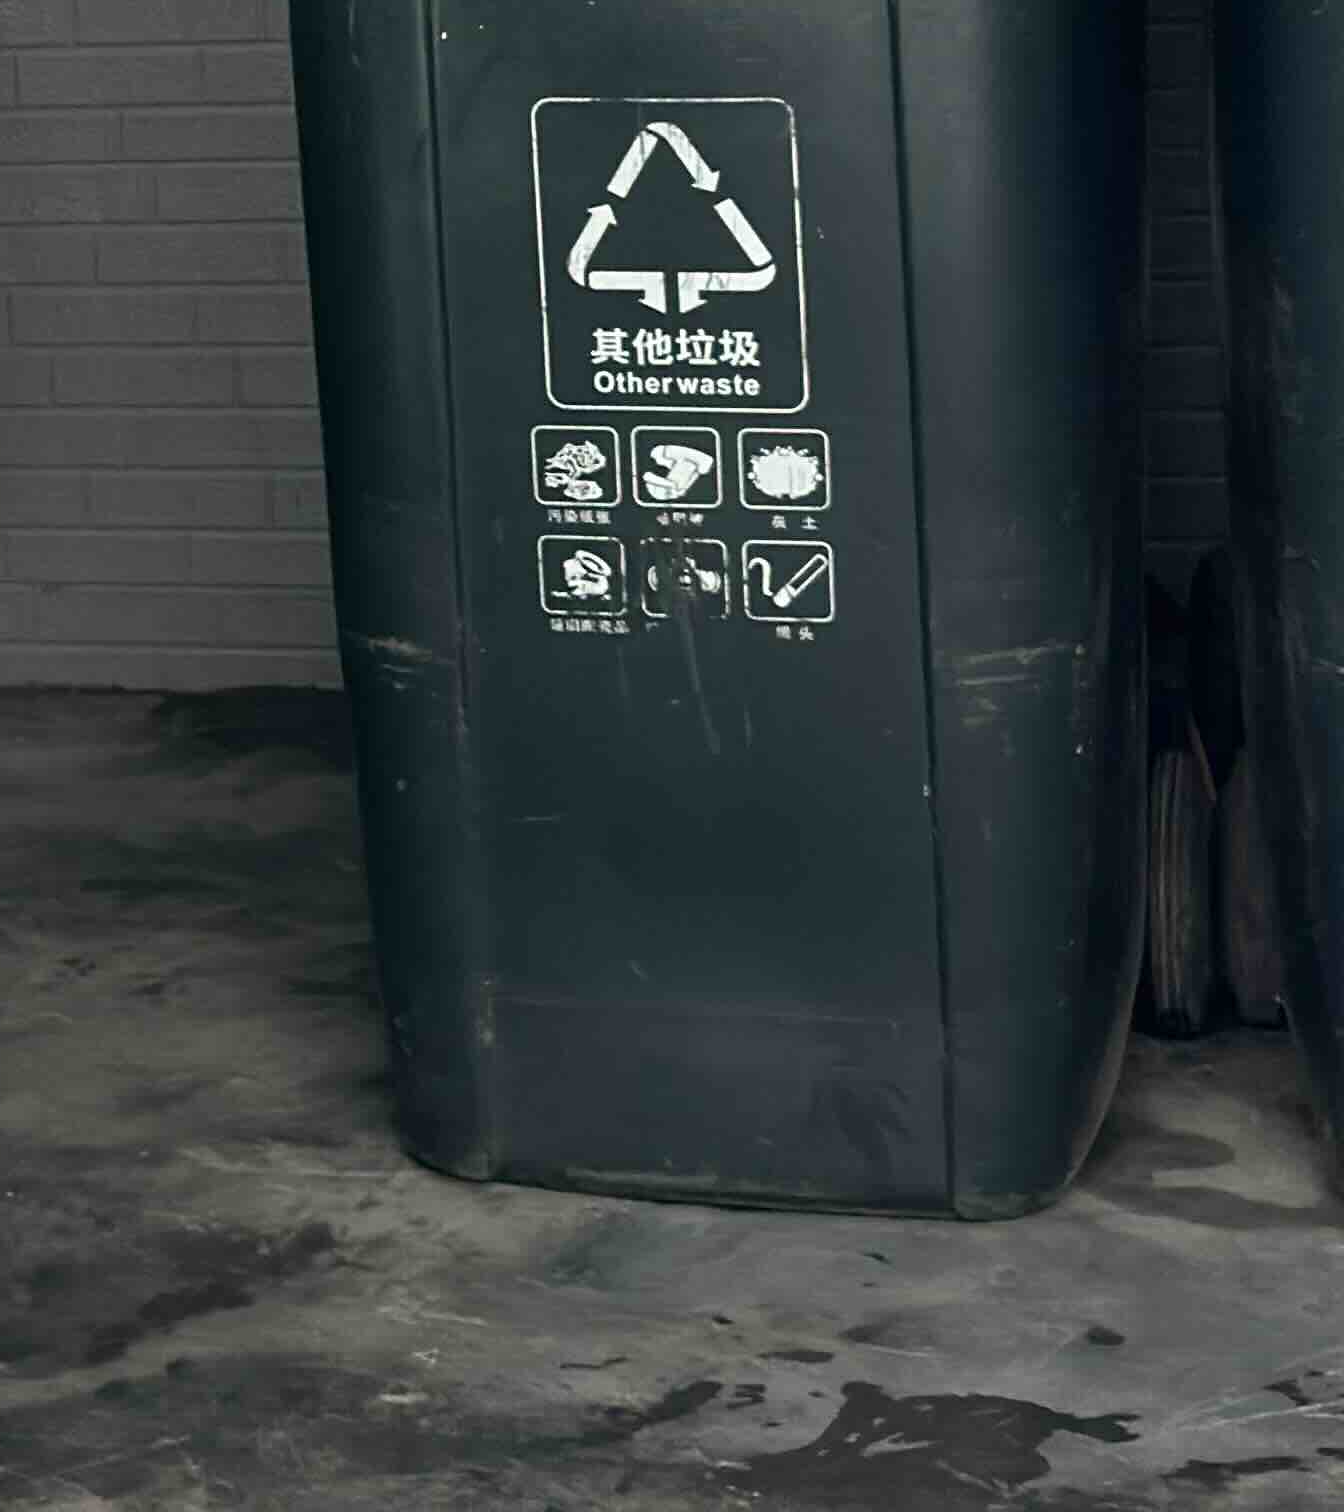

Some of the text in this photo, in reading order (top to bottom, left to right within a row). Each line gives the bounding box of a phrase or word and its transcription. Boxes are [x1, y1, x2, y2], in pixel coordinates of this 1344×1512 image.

[589, 327, 761, 367] 其他垃圾
[593, 370, 761, 396] Other waste
